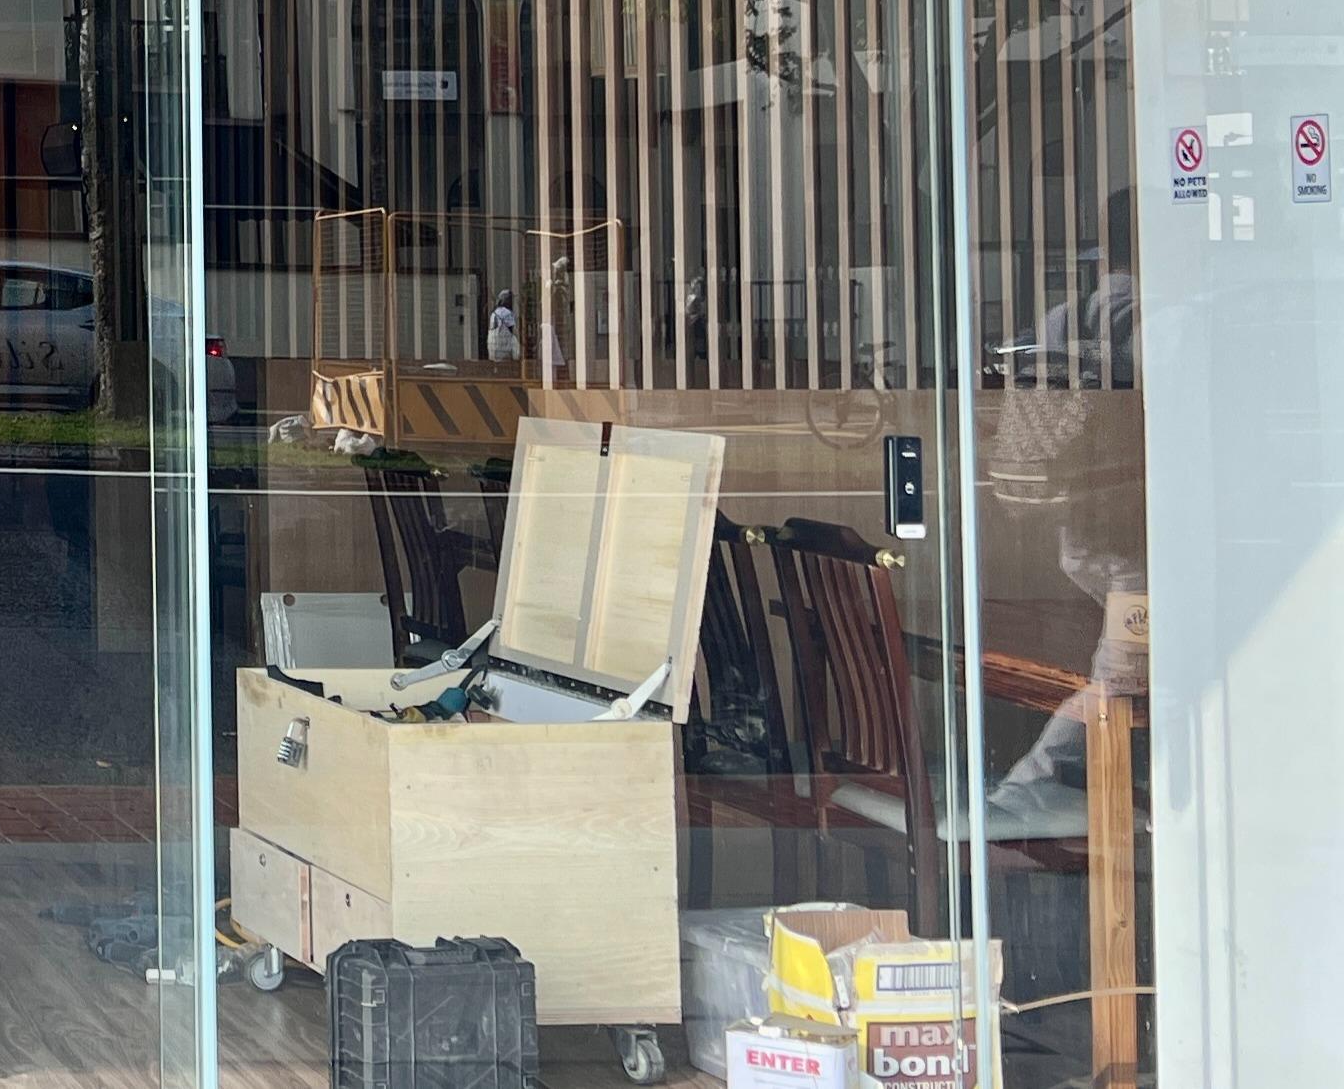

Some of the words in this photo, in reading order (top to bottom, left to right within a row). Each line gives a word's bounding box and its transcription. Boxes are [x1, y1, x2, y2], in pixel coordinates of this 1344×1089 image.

[1173, 176, 1186, 188] NO
[1187, 175, 1207, 187] PETS
[1305, 173, 1317, 184] NO
[1173, 189, 1208, 200] ALLOWED
[1297, 185, 1327, 196] SMOKING
[745, 1048, 822, 1076] ENTER
[873, 1044, 970, 1077] bond
